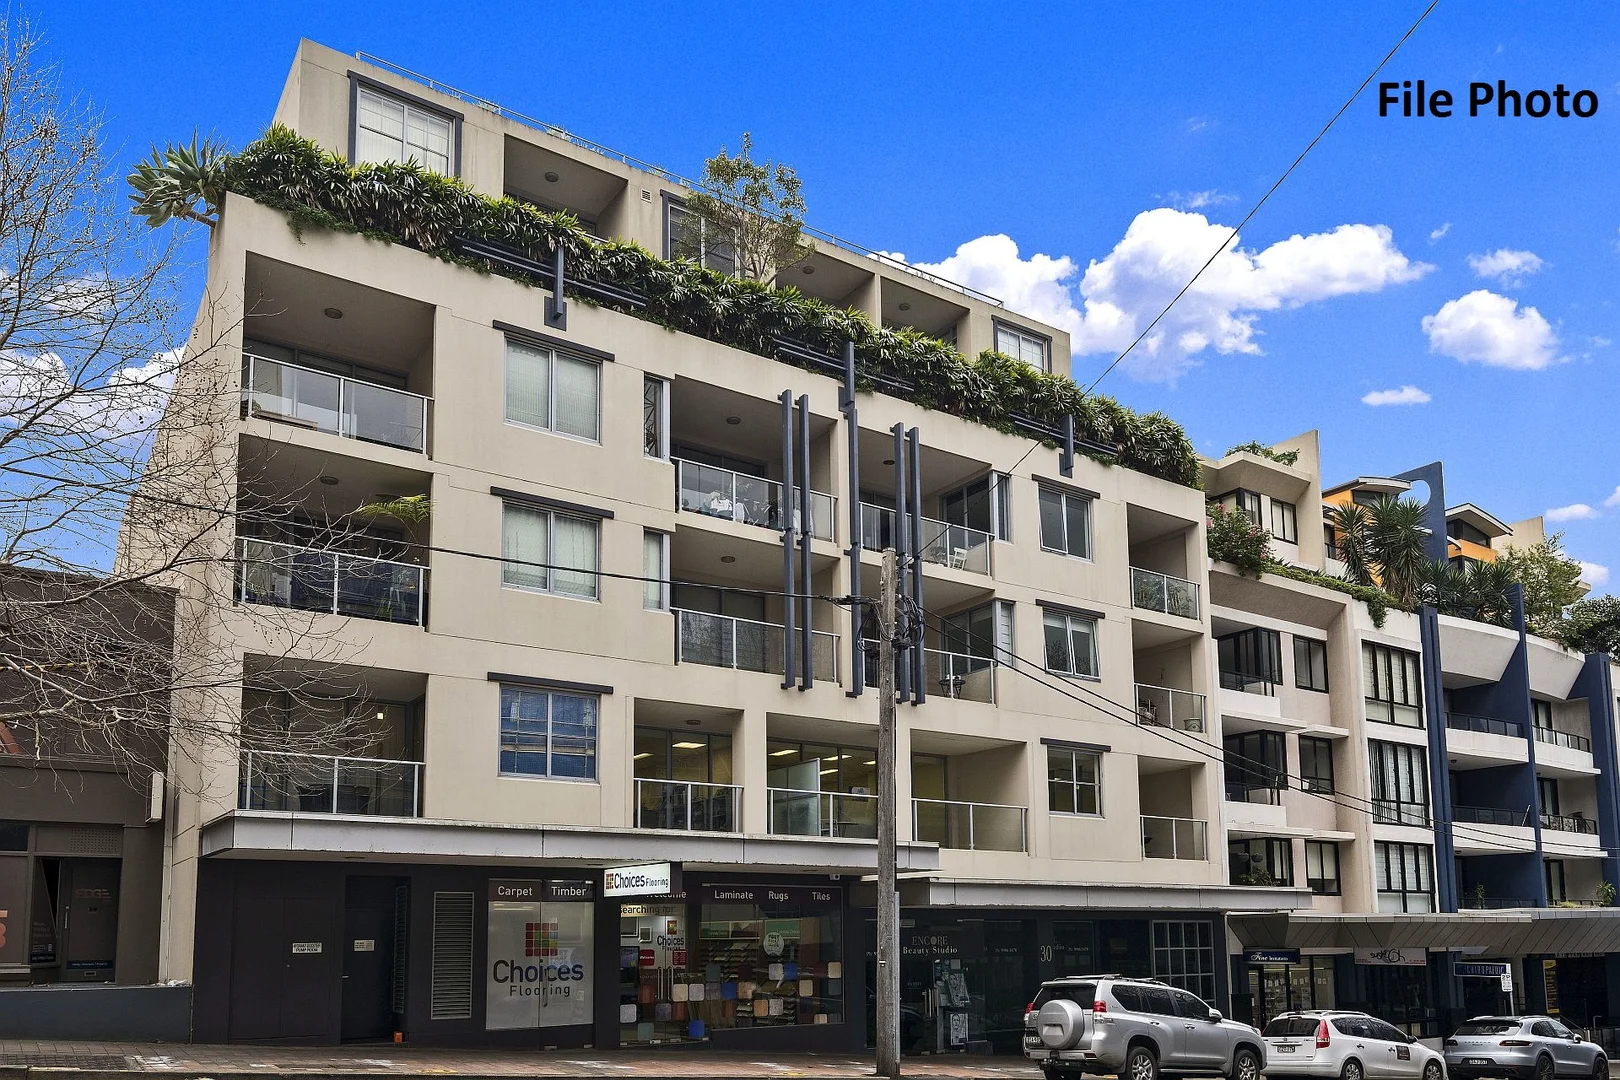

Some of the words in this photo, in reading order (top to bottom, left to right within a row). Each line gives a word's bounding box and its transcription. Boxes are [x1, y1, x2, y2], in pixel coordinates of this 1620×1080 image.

[614, 872, 645, 889] Choices
[645, 877, 669, 888] Flooring
[497, 885, 533, 898] Carpet
[551, 886, 587, 896] Timber
[714, 890, 754, 900] Laminate
[768, 891, 789, 901] Rugs
[812, 891, 831, 901] Tiles
[657, 935, 684, 946] Choices
[912, 936, 949, 946] ENCORE
[902, 947, 929, 956] Beauty
[932, 946, 958, 954] Studio
[1040, 945, 1052, 962] 30
[493, 959, 584, 984] Choices
[509, 984, 571, 998] Flooring
